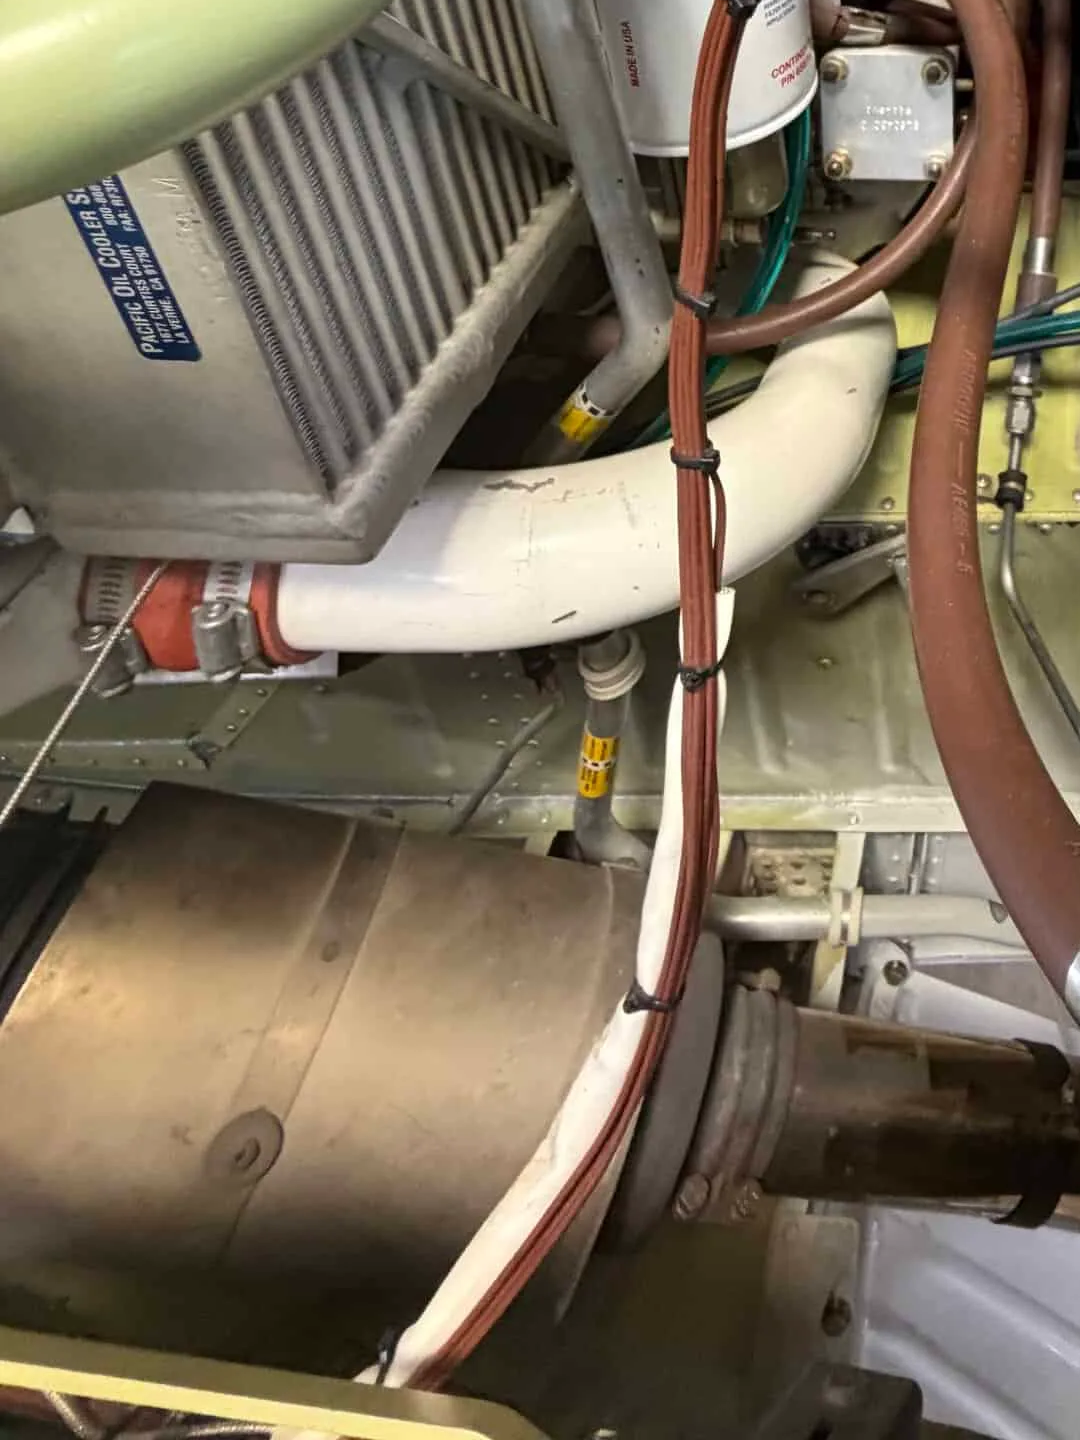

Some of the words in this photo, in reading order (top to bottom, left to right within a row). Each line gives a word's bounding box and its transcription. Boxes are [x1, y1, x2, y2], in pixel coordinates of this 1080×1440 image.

[621, 21, 633, 43] USA
[625, 45, 634, 57] IN
[627, 58, 640, 88] MADE
[79, 210, 121, 269] COOLER
[115, 242, 143, 278] COURT
[111, 273, 136, 298] OIL
[147, 277, 165, 291] CA
[133, 279, 162, 320] CURTISS
[124, 302, 164, 354] PACIFIC
[173, 331, 191, 345] LA
